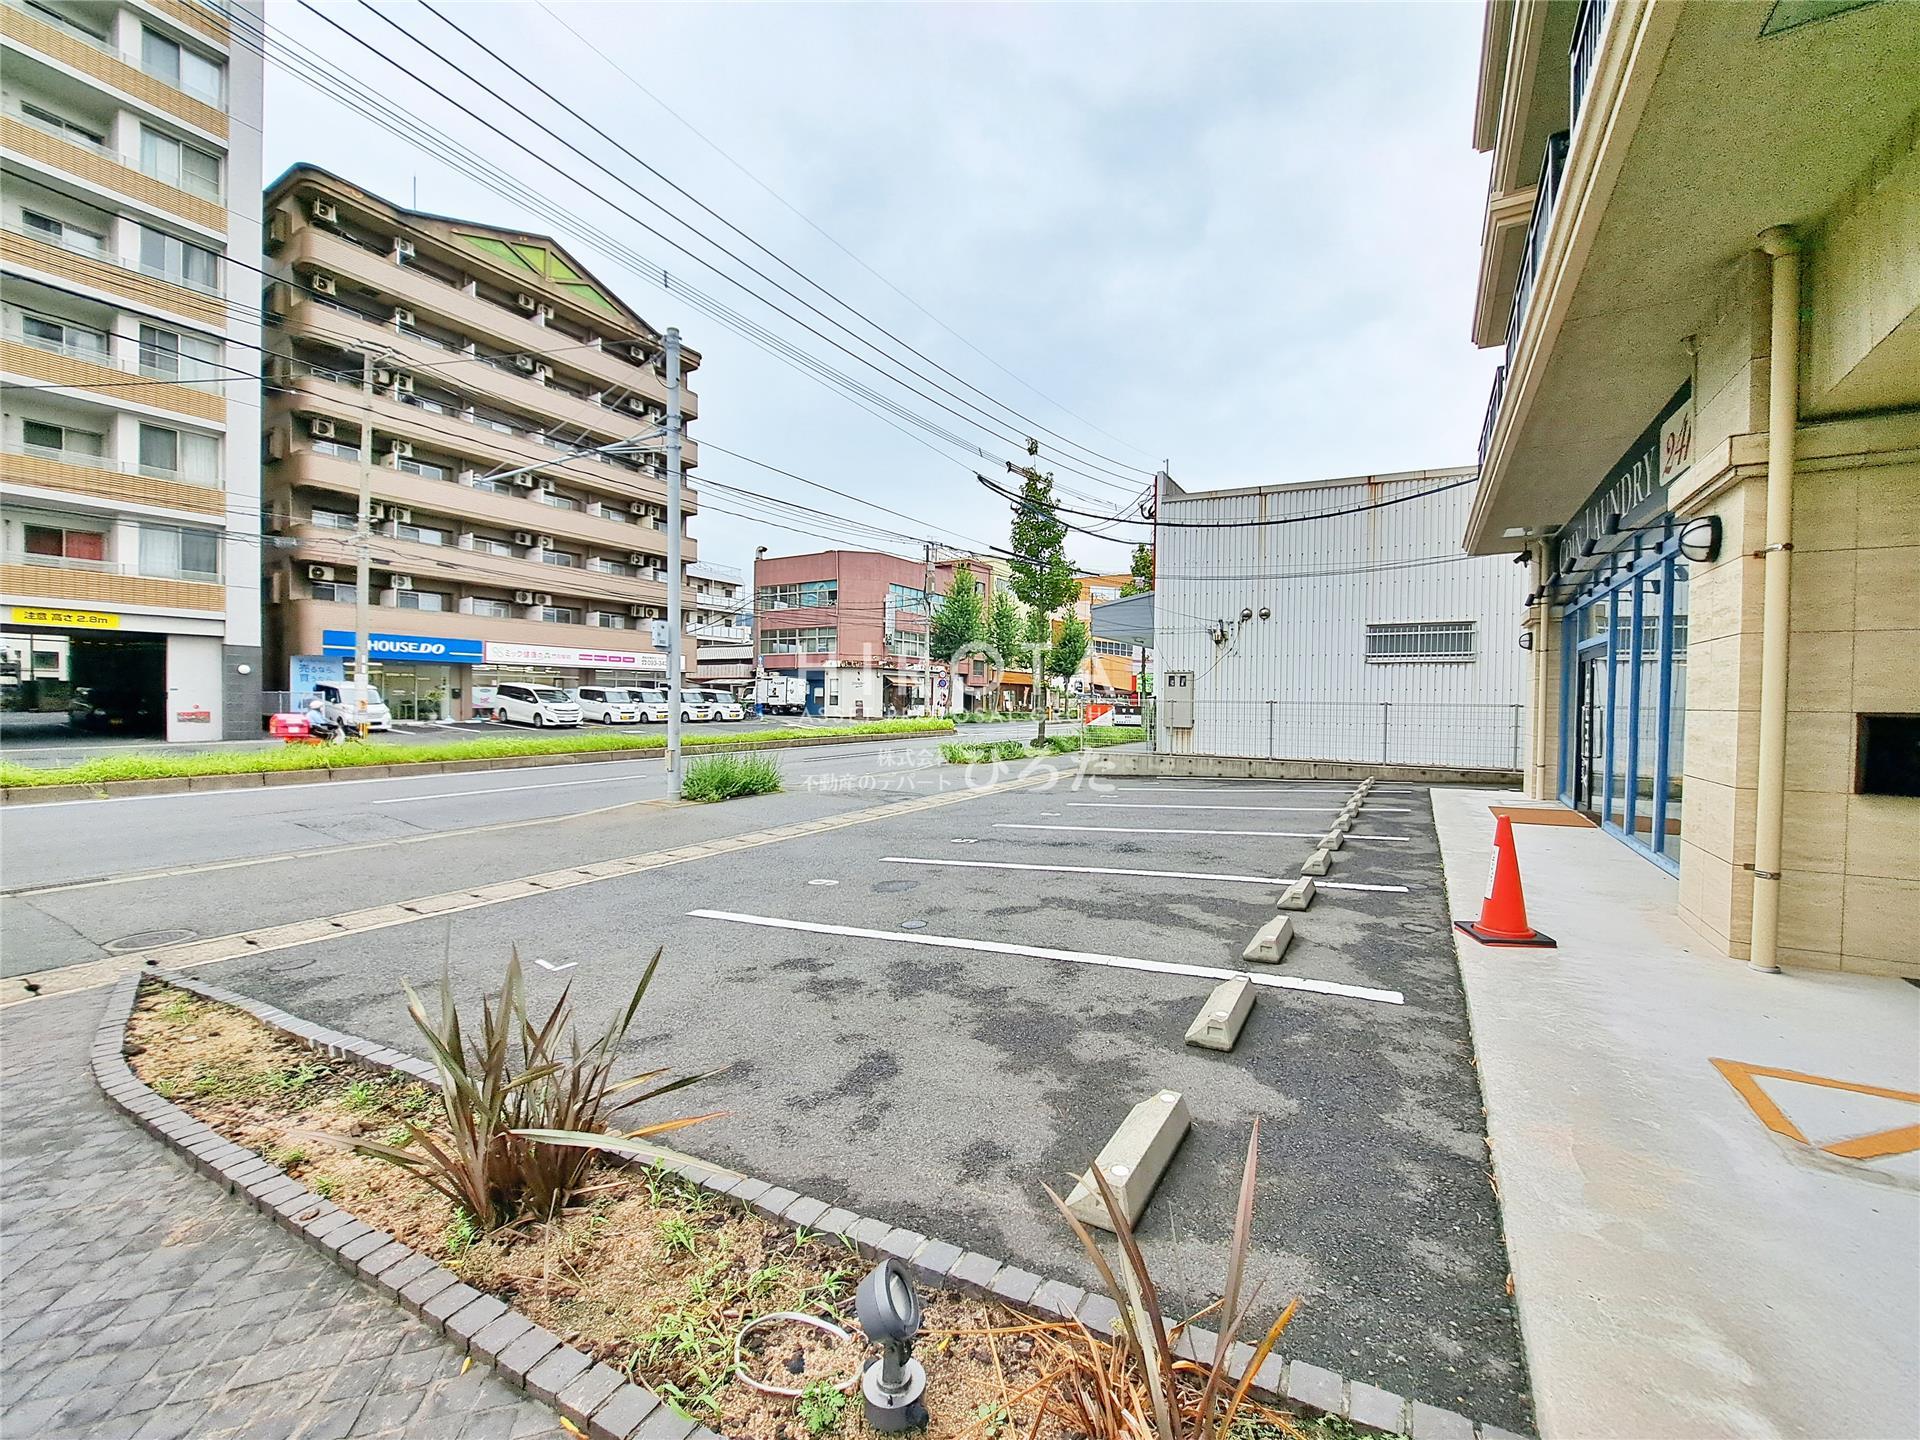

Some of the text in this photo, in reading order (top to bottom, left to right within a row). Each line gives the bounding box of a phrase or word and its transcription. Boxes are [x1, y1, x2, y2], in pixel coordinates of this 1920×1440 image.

[1585, 446, 1656, 542] LAUNDRY
[51, 613, 73, 622] 高さ
[77, 615, 108, 624] 2.8m
